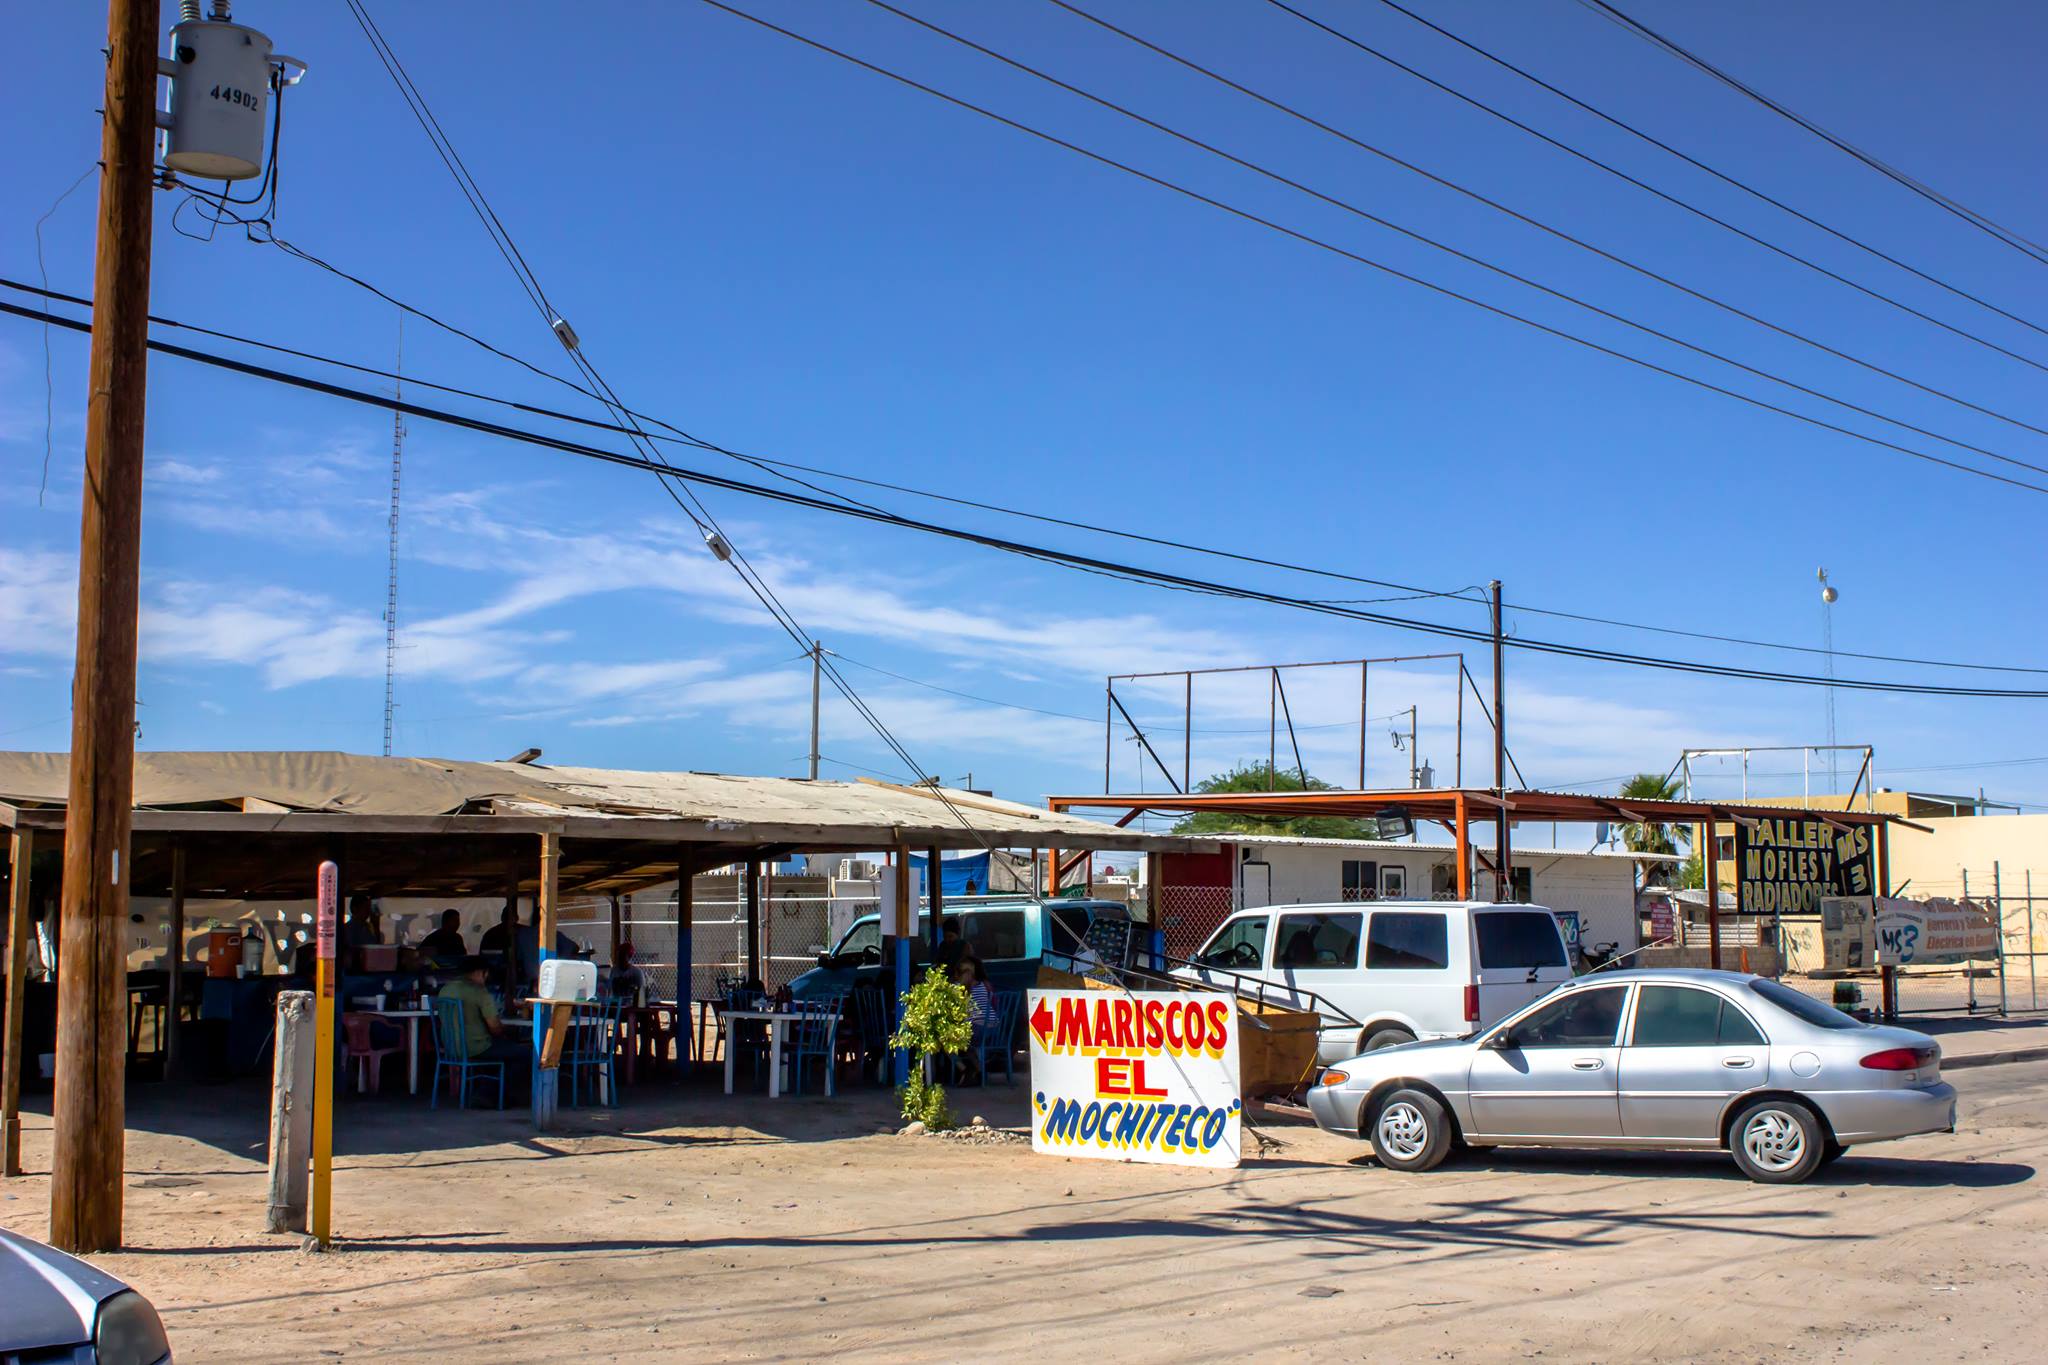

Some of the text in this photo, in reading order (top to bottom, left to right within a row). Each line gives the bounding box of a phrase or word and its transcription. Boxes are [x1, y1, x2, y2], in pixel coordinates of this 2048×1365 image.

[210, 85, 258, 112] 44902
[1743, 818, 1833, 849] TALLER
[1836, 826, 1868, 864] MS
[1746, 849, 1832, 881] MOFLES Y
[1851, 864, 1867, 893] 3
[1051, 997, 1229, 1060] MARISCOS
[1094, 1057, 1169, 1101] EL
